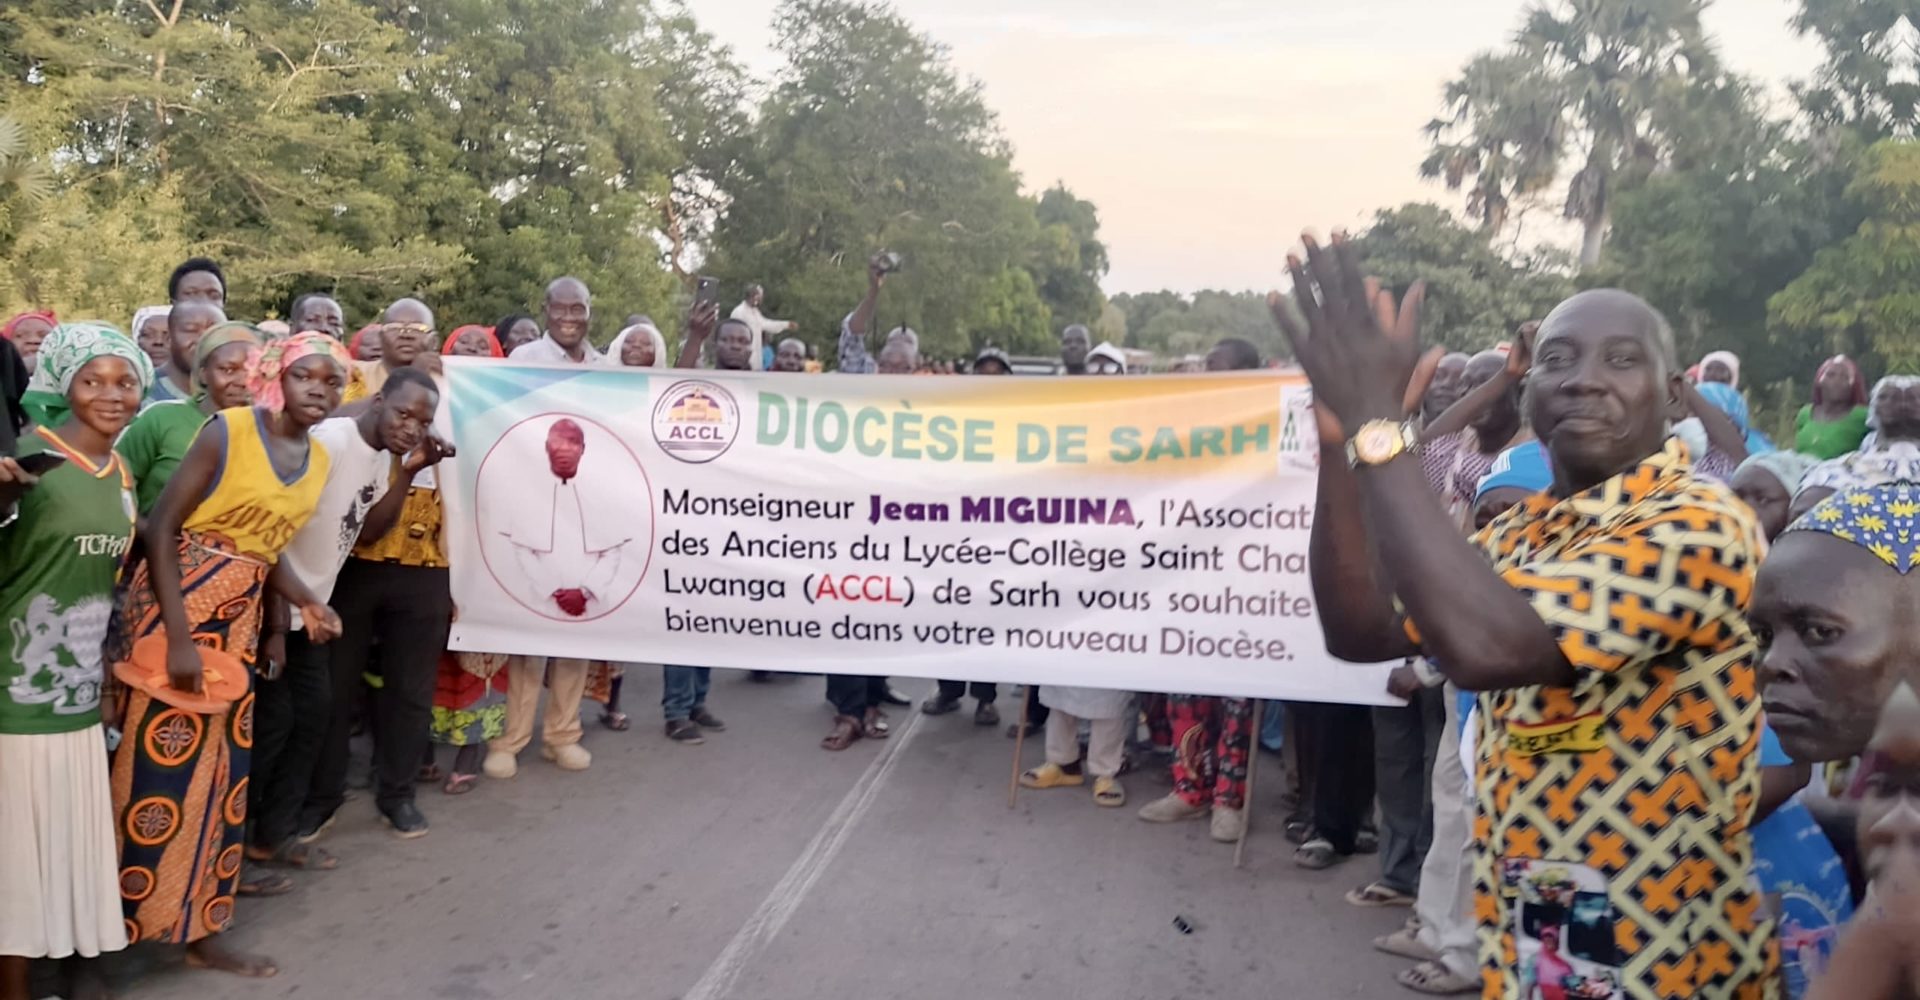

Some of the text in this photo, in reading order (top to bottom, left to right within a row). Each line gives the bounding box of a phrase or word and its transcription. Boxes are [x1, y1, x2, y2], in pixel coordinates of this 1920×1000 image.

[669, 425, 724, 440] ACCL
[757, 391, 995, 462] DIOCÈSE
[1016, 423, 1088, 463] DE
[1110, 424, 1269, 463] SARH
[662, 488, 1311, 531] Monseigneur Jean MIGUINA, l'Associat
[74, 534, 128, 557] TCHA
[661, 529, 1306, 574] des Anciens du Lycée-Collège Saint Cha
[663, 568, 1312, 618] Lwanga (ACCL) de Sarh vous souhaite
[666, 608, 1295, 662] bienvenue dans votre nouveau Diocèse.
